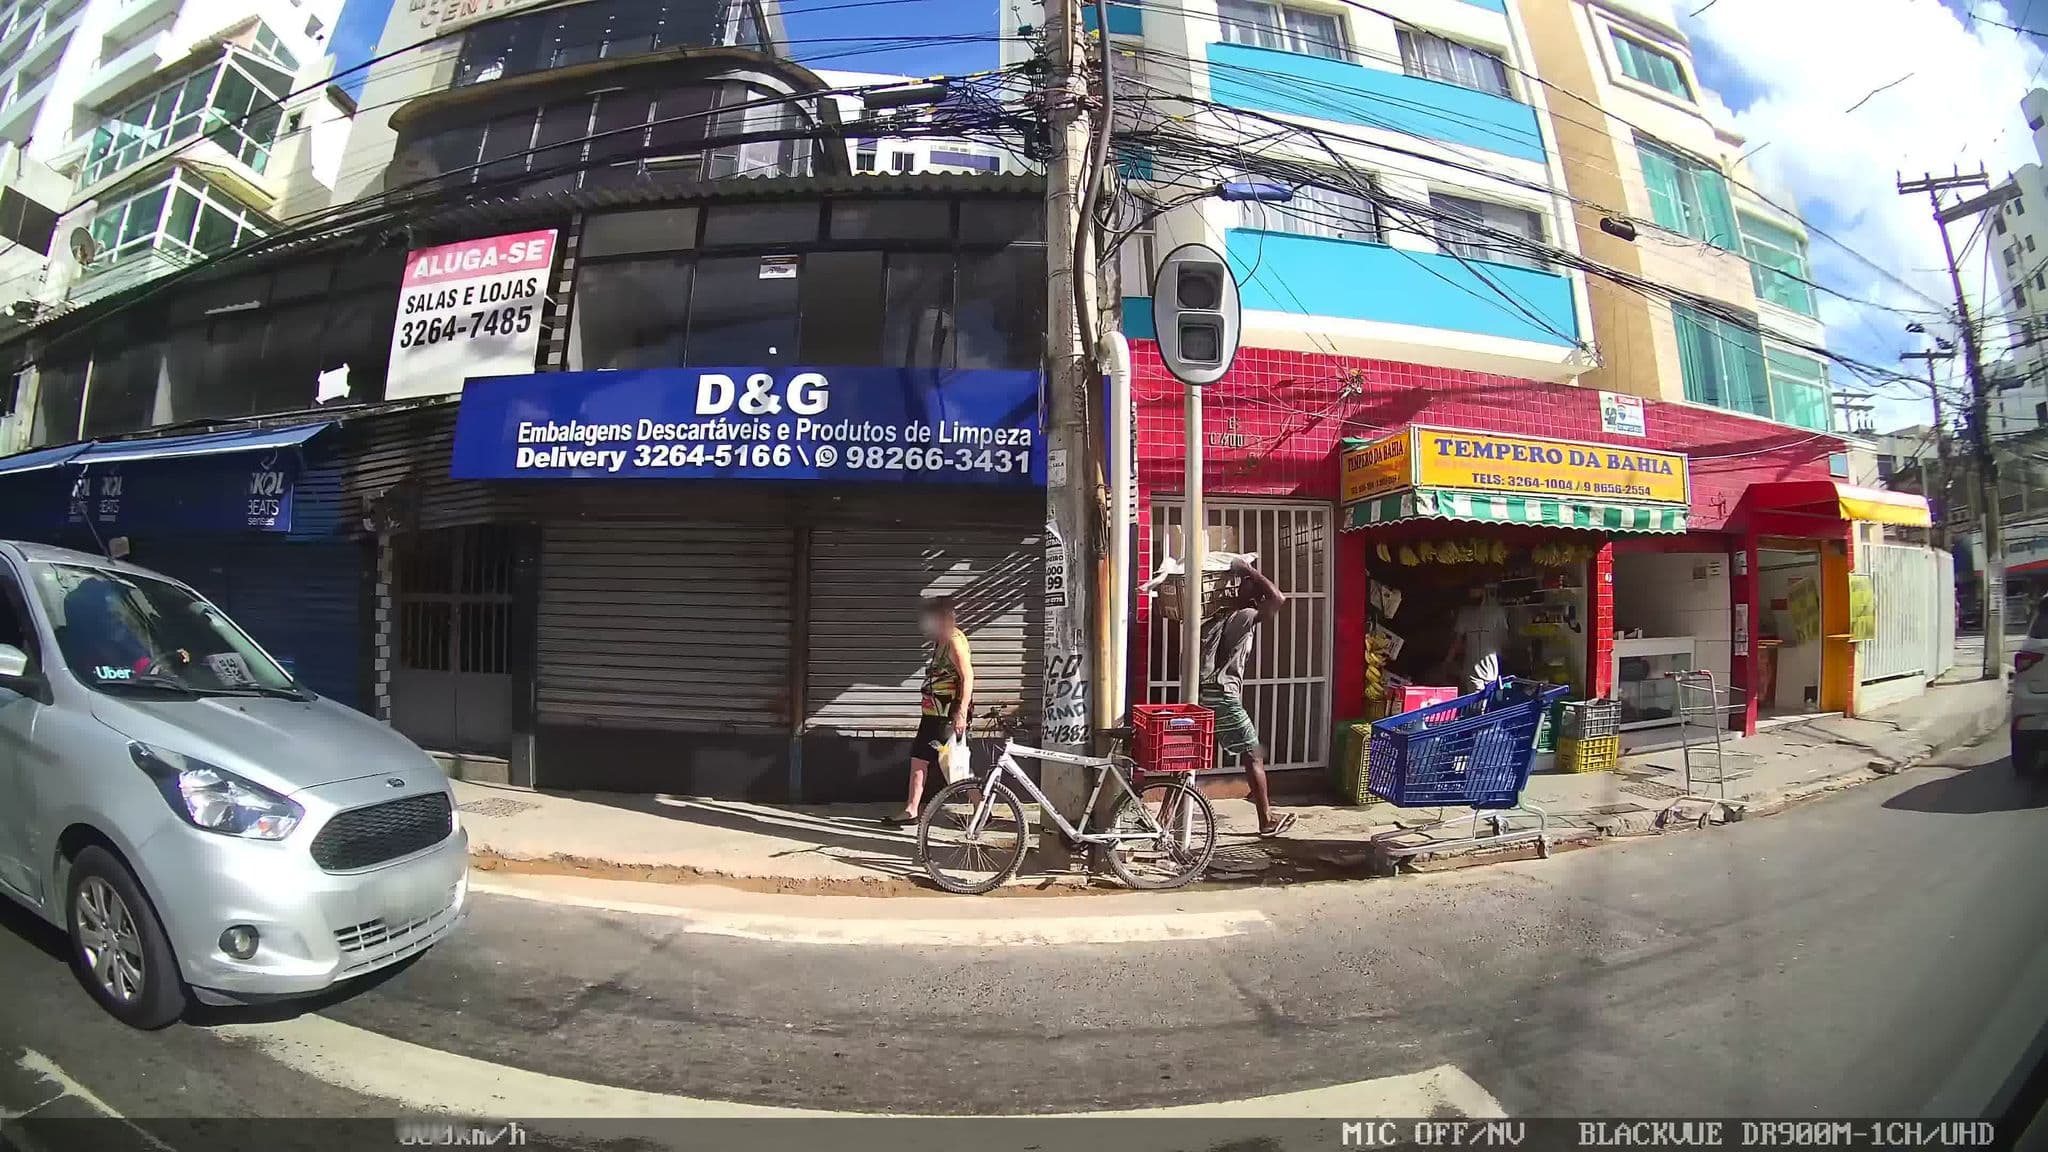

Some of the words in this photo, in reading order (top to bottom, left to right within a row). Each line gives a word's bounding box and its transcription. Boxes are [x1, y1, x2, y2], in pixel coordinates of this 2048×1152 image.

[413, 239, 546, 279] ALUGA-SE
[405, 289, 458, 315] SALAS
[463, 286, 475, 306] E
[479, 277, 538, 304] LOJAS
[400, 305, 533, 349] 3264-7485
[695, 373, 830, 415] D&G
[518, 420, 632, 446] Embalagens
[637, 417, 771, 441] Descartáveis
[777, 422, 790, 441] e
[796, 418, 897, 442] Produtos
[904, 420, 931, 442] de
[938, 420, 1032, 449] Limpeza
[516, 447, 627, 472] Delivery
[633, 444, 792, 468] 3264-5166
[846, 446, 1030, 474] 98266-3431
[1434, 438, 1563, 465] TEMPERO
[1568, 449, 1602, 468] DA
[1606, 453, 1673, 476] BAHIA
[1472, 472, 1505, 486] TELS:
[1507, 475, 1573, 490] 3264-1004
[1583, 481, 1591, 492] 9
[96, 666, 132, 680] Uber
